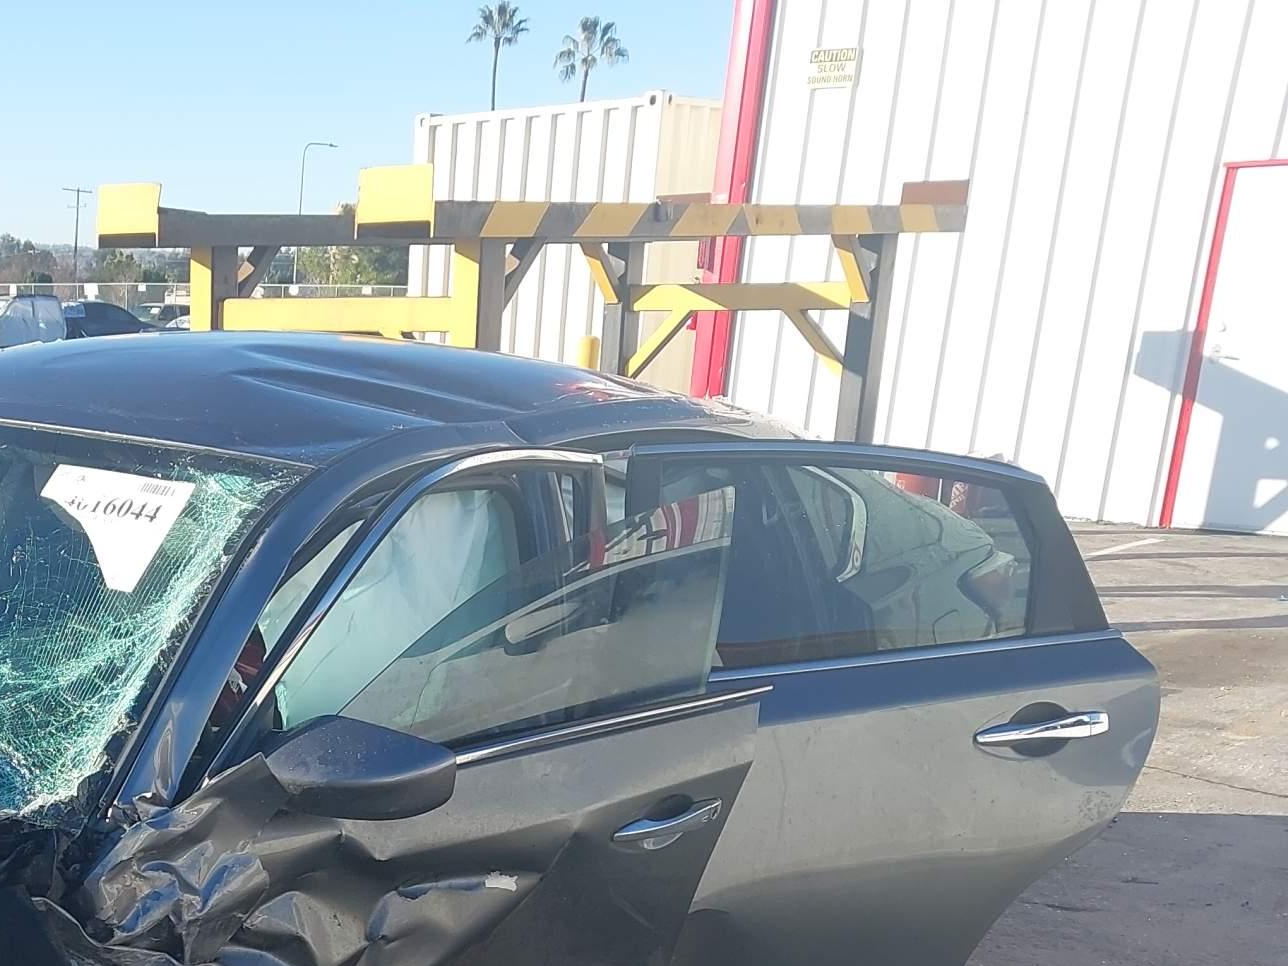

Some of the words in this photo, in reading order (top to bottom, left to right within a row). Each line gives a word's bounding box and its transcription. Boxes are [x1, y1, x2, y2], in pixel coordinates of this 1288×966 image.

[811, 49, 856, 63] CAUTION
[817, 63, 846, 73] SLOW
[808, 75, 831, 84] SOUND
[833, 74, 853, 83] HORN
